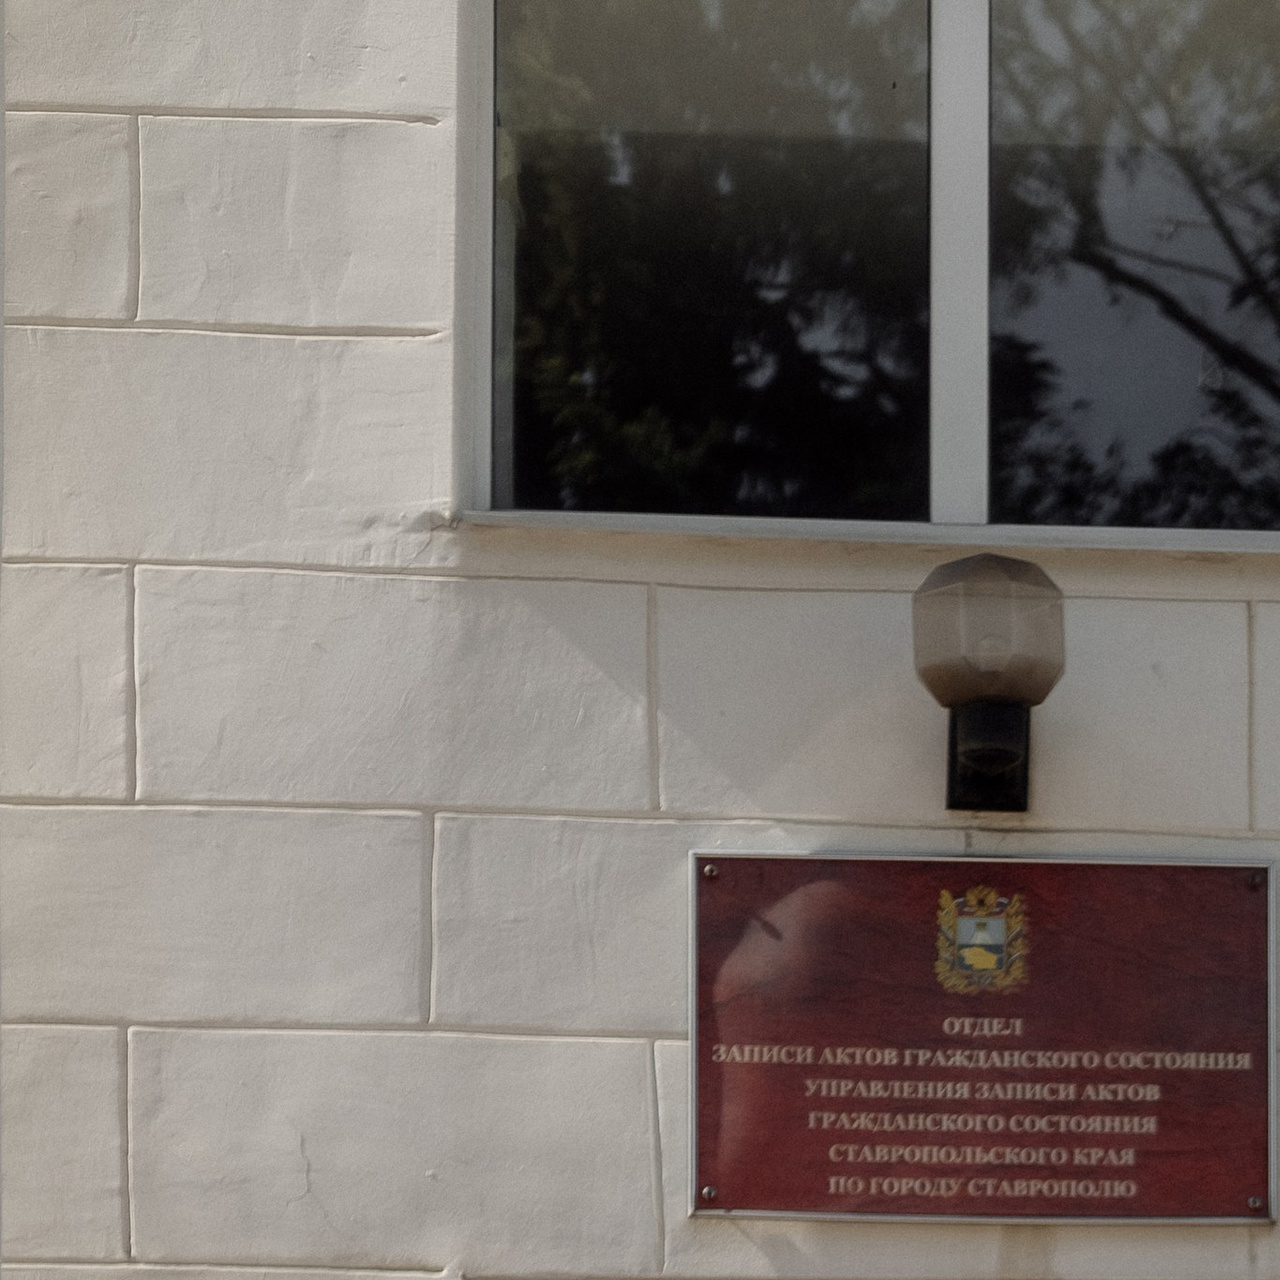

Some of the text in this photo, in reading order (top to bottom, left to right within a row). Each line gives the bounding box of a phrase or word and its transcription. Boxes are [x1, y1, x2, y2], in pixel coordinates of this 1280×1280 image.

[942, 1017, 1023, 1037] ОТДЕЛ
[712, 1044, 1252, 1070] ЗАПИСИ АКТОВ ГРАЖДАНСКОГО СОСТОЯНИЯ
[805, 1079, 1160, 1101] УПРАВЛЕНИЯ ЗАПИСИ АКТОВ
[808, 1111, 1157, 1134] ГРАЖДАНСКОГО СОСТОЯНИЯ
[828, 1144, 1135, 1166] СТАВРОПОЛЬСКОГО КРАЯ
[828, 1176, 1137, 1198] ПО ГОРОДУ СТАВРОПОЛЮ
